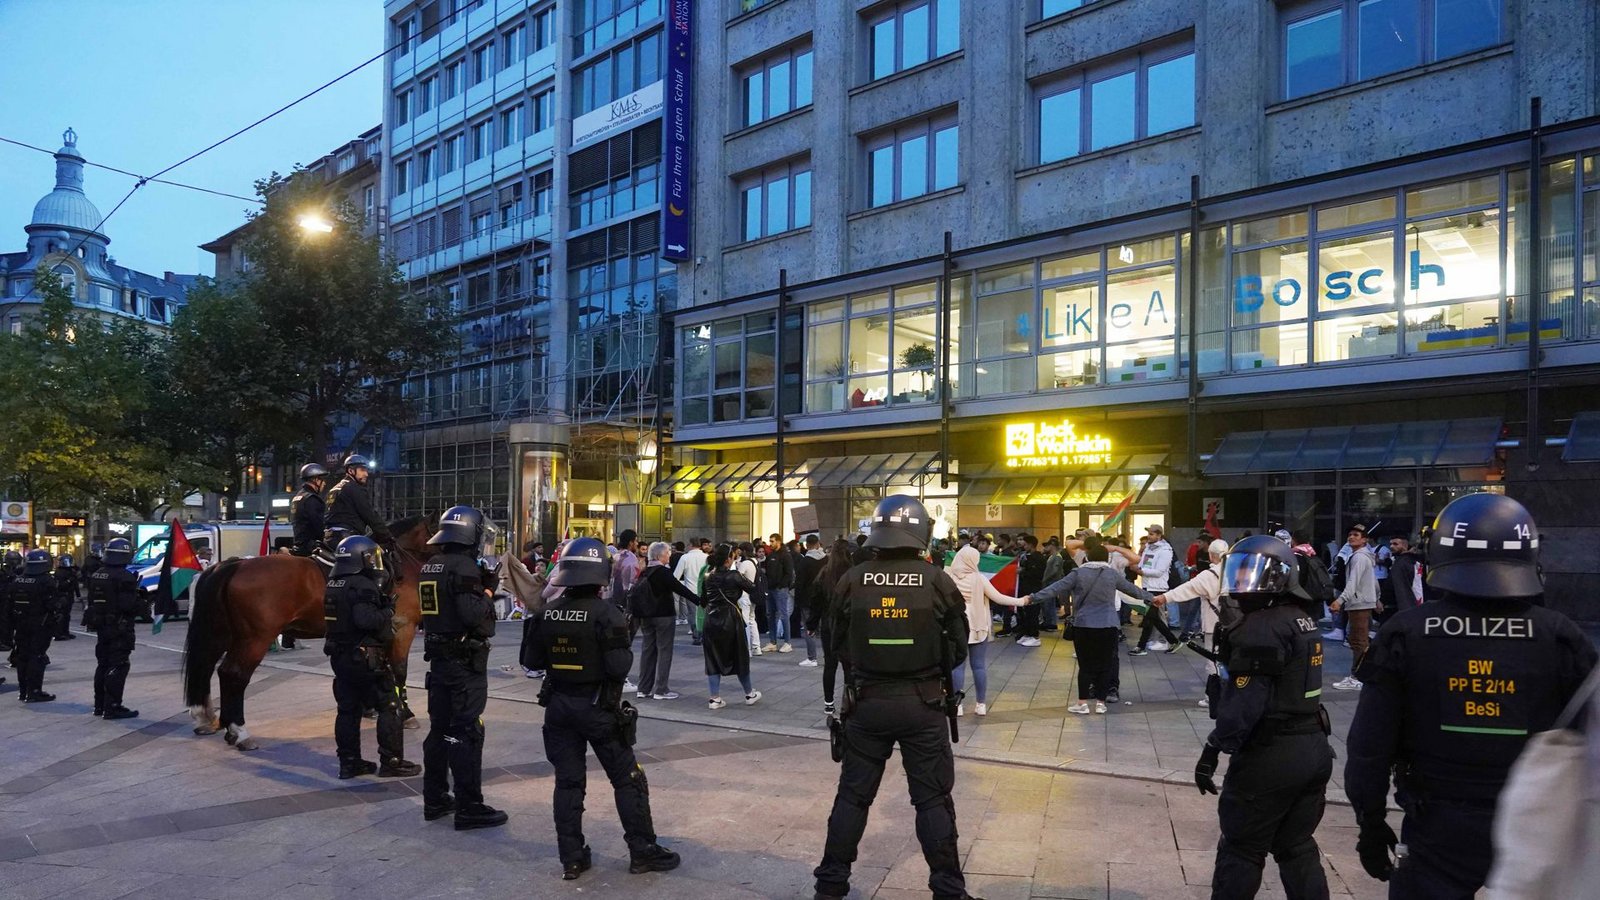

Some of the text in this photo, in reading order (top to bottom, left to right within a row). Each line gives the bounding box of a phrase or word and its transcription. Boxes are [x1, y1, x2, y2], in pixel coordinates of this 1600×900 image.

[673, 67, 685, 198] Für Ihren guten Schlaf
[1144, 290, 1168, 326] A
[1235, 249, 1445, 314] Bosch
[898, 507, 910, 517] 14
[1453, 522, 1468, 539] E
[1514, 523, 1531, 540] 14
[587, 548, 599, 557] 13
[420, 563, 445, 573] POLIZEI
[863, 572, 923, 586] POLIZEI
[881, 597, 896, 607] BW
[544, 609, 588, 622] POLIZEI
[870, 608, 909, 618] PP E 2/12
[1424, 615, 1534, 638] POLIZEI
[1468, 660, 1494, 675] BW
[1449, 677, 1515, 694] PP E 2/14
[1465, 701, 1501, 717] BeSi
